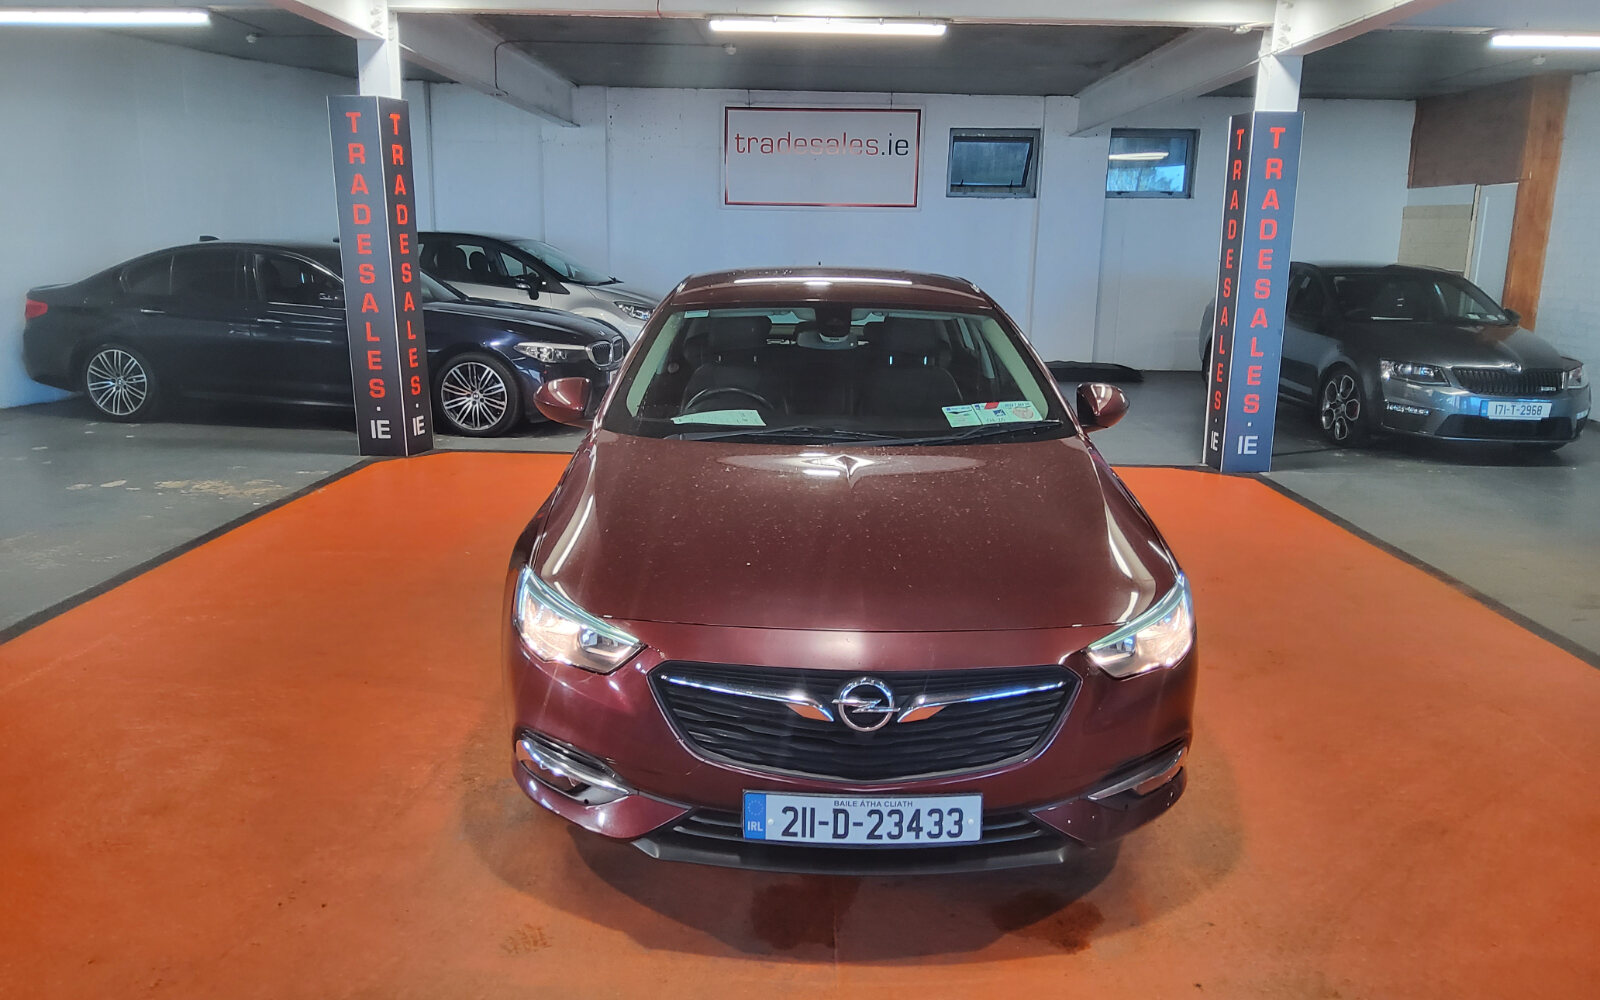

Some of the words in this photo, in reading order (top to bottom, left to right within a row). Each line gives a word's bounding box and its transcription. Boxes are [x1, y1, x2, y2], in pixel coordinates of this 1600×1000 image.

[735, 131, 909, 156] tradesales.ie
[1494, 404, 1543, 416] 171-T-2968
[859, 799, 882, 808] ÁTHA
[883, 800, 913, 808] CLIATH
[747, 820, 764, 832] IRL
[781, 806, 964, 840] 211-D-23433
